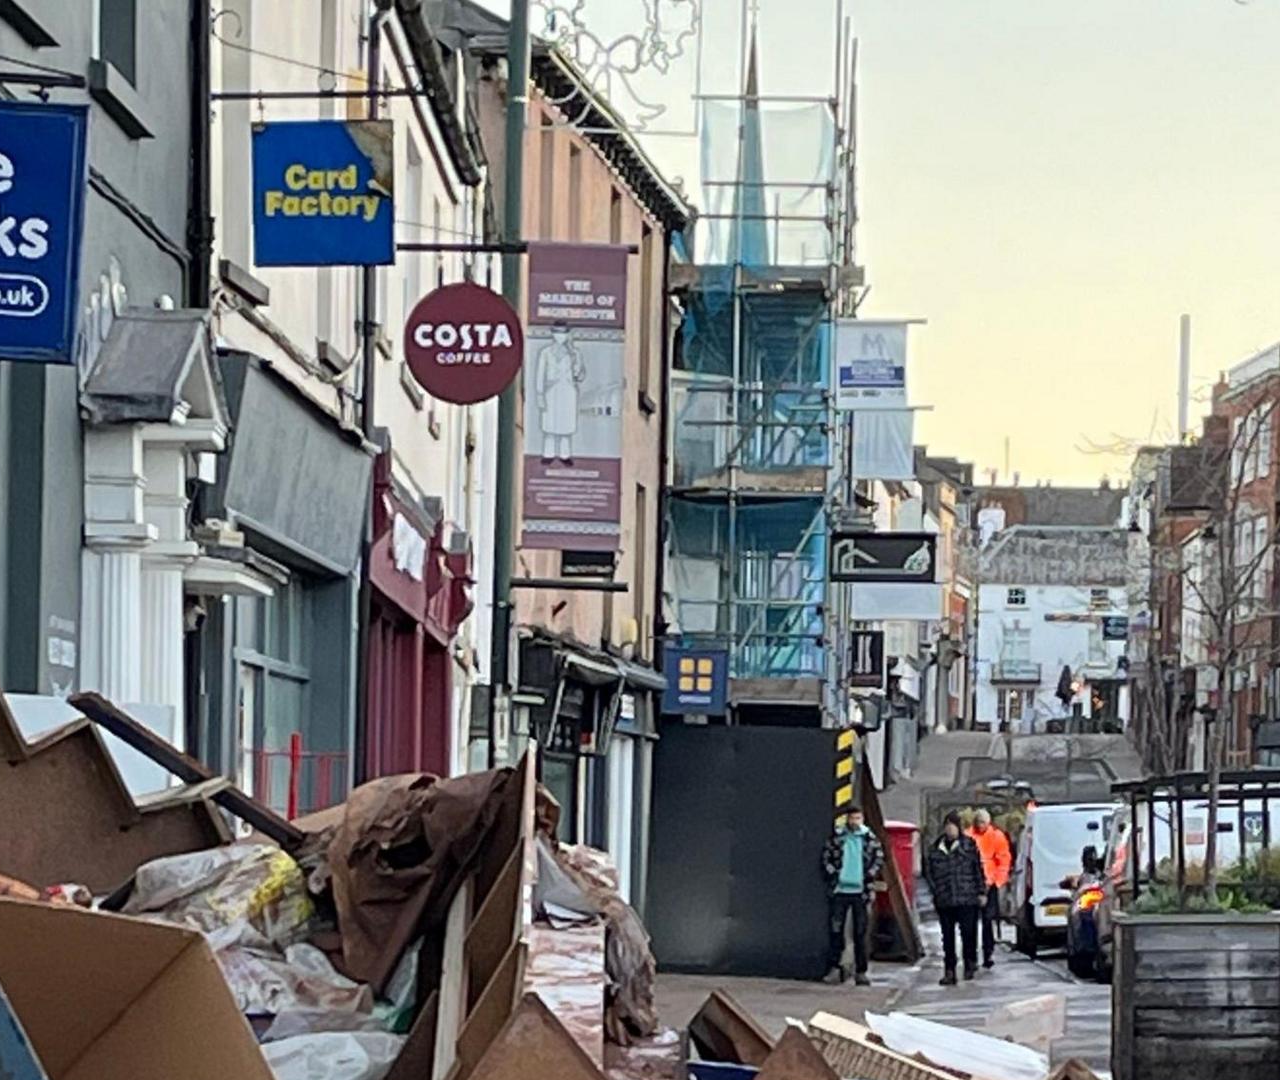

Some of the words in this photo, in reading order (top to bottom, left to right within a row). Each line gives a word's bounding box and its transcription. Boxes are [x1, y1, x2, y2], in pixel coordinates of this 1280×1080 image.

[285, 164, 357, 191] Card
[265, 191, 380, 222] Factory
[563, 280, 591, 292] THE
[596, 295, 616, 307] OF
[414, 323, 513, 350] COSTA
[436, 352, 491, 365] COFFEE
